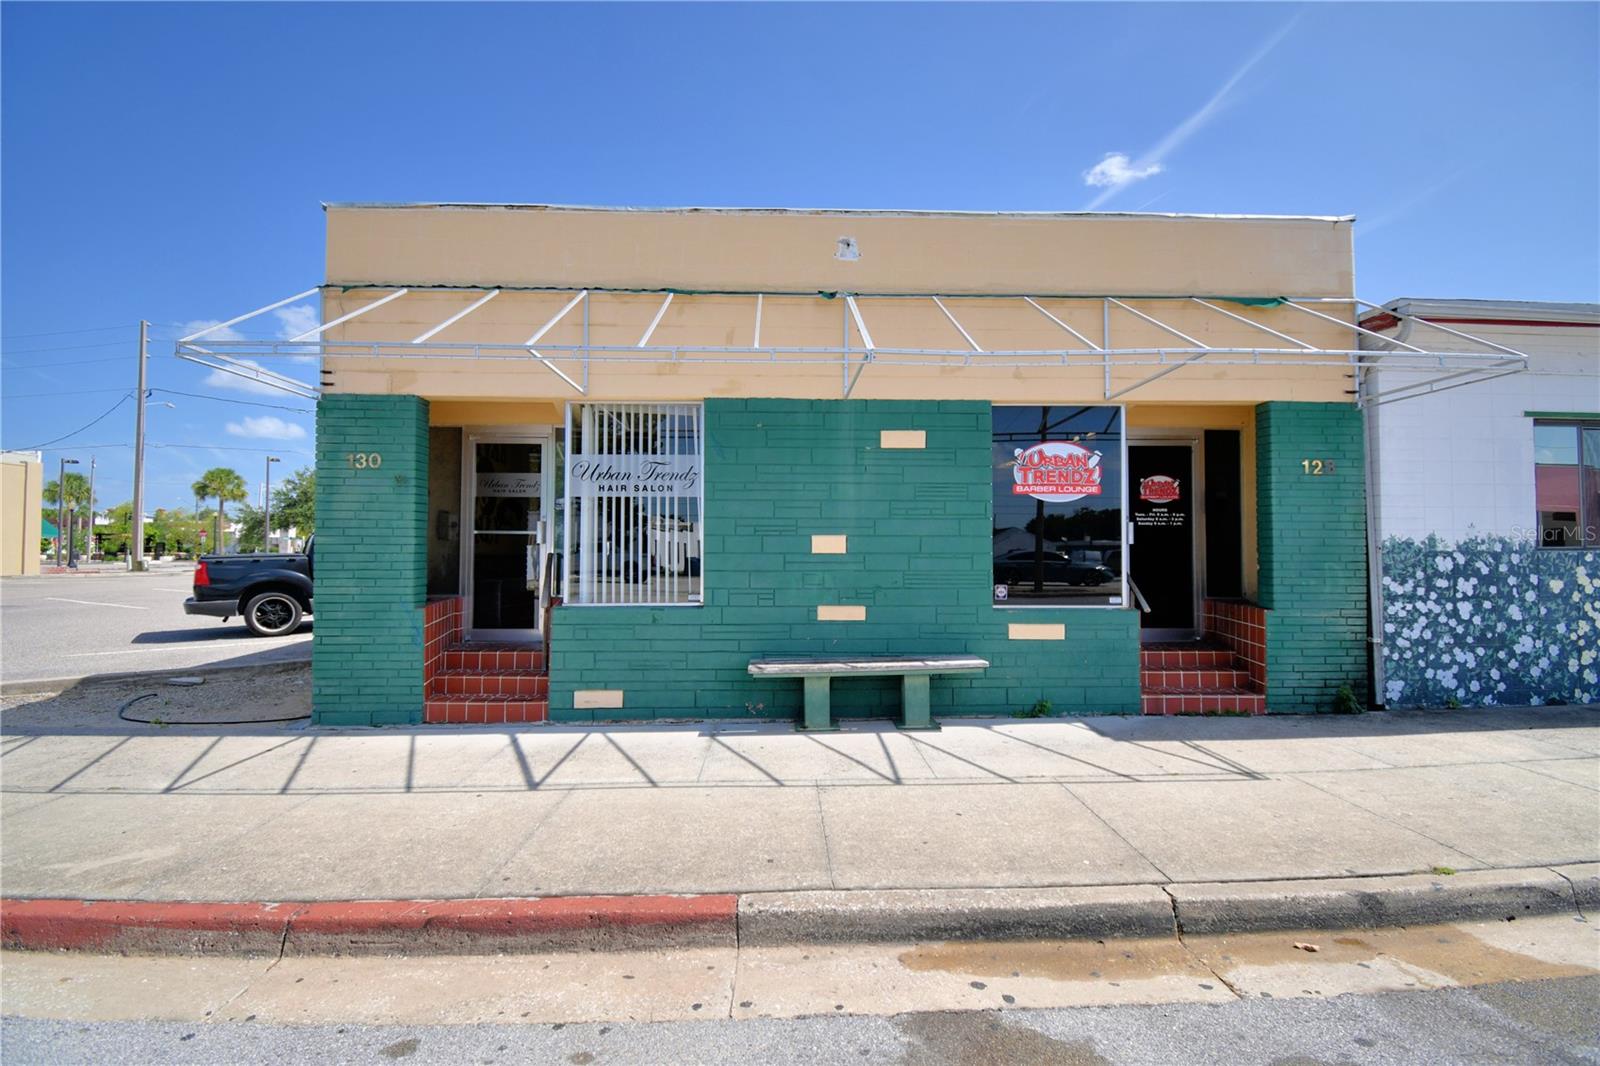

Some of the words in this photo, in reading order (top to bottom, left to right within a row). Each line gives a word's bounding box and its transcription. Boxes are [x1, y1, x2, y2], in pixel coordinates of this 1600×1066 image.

[346, 453, 381, 468] 130
[1026, 448, 1089, 468] URBAN
[571, 460, 632, 482] Urban
[637, 461, 699, 489] Trendz
[1018, 467, 1095, 485] TRENDZ
[1016, 485, 1056, 493] BARBER
[1058, 485, 1099, 493] LOUNGE
